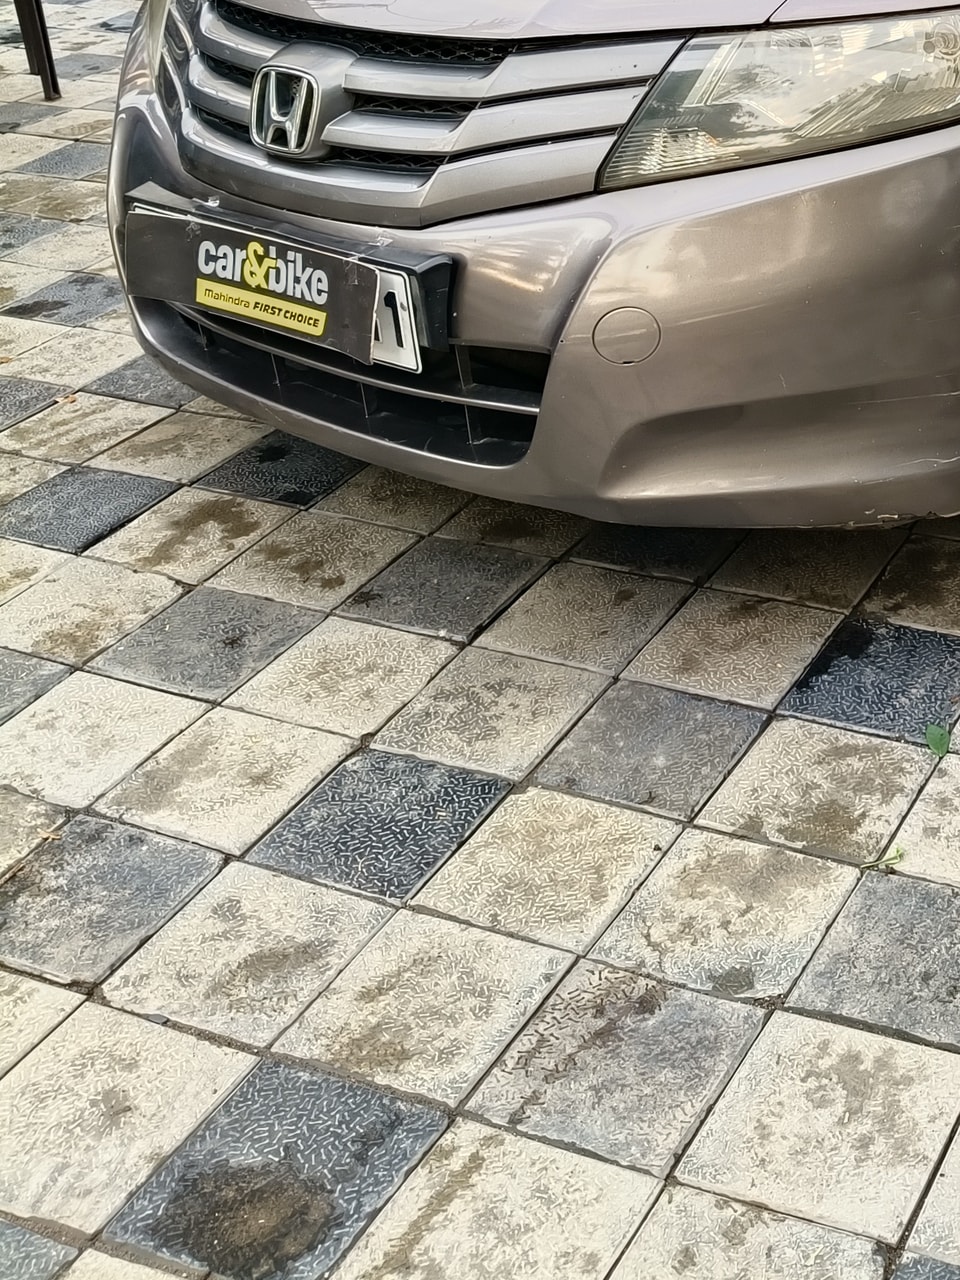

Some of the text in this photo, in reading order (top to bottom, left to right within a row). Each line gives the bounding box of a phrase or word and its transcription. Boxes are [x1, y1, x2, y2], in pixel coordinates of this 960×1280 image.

[197, 240, 329, 306] car&bike
[253, 301, 283, 317] FIRST
[283, 309, 320, 328] CHOICE
